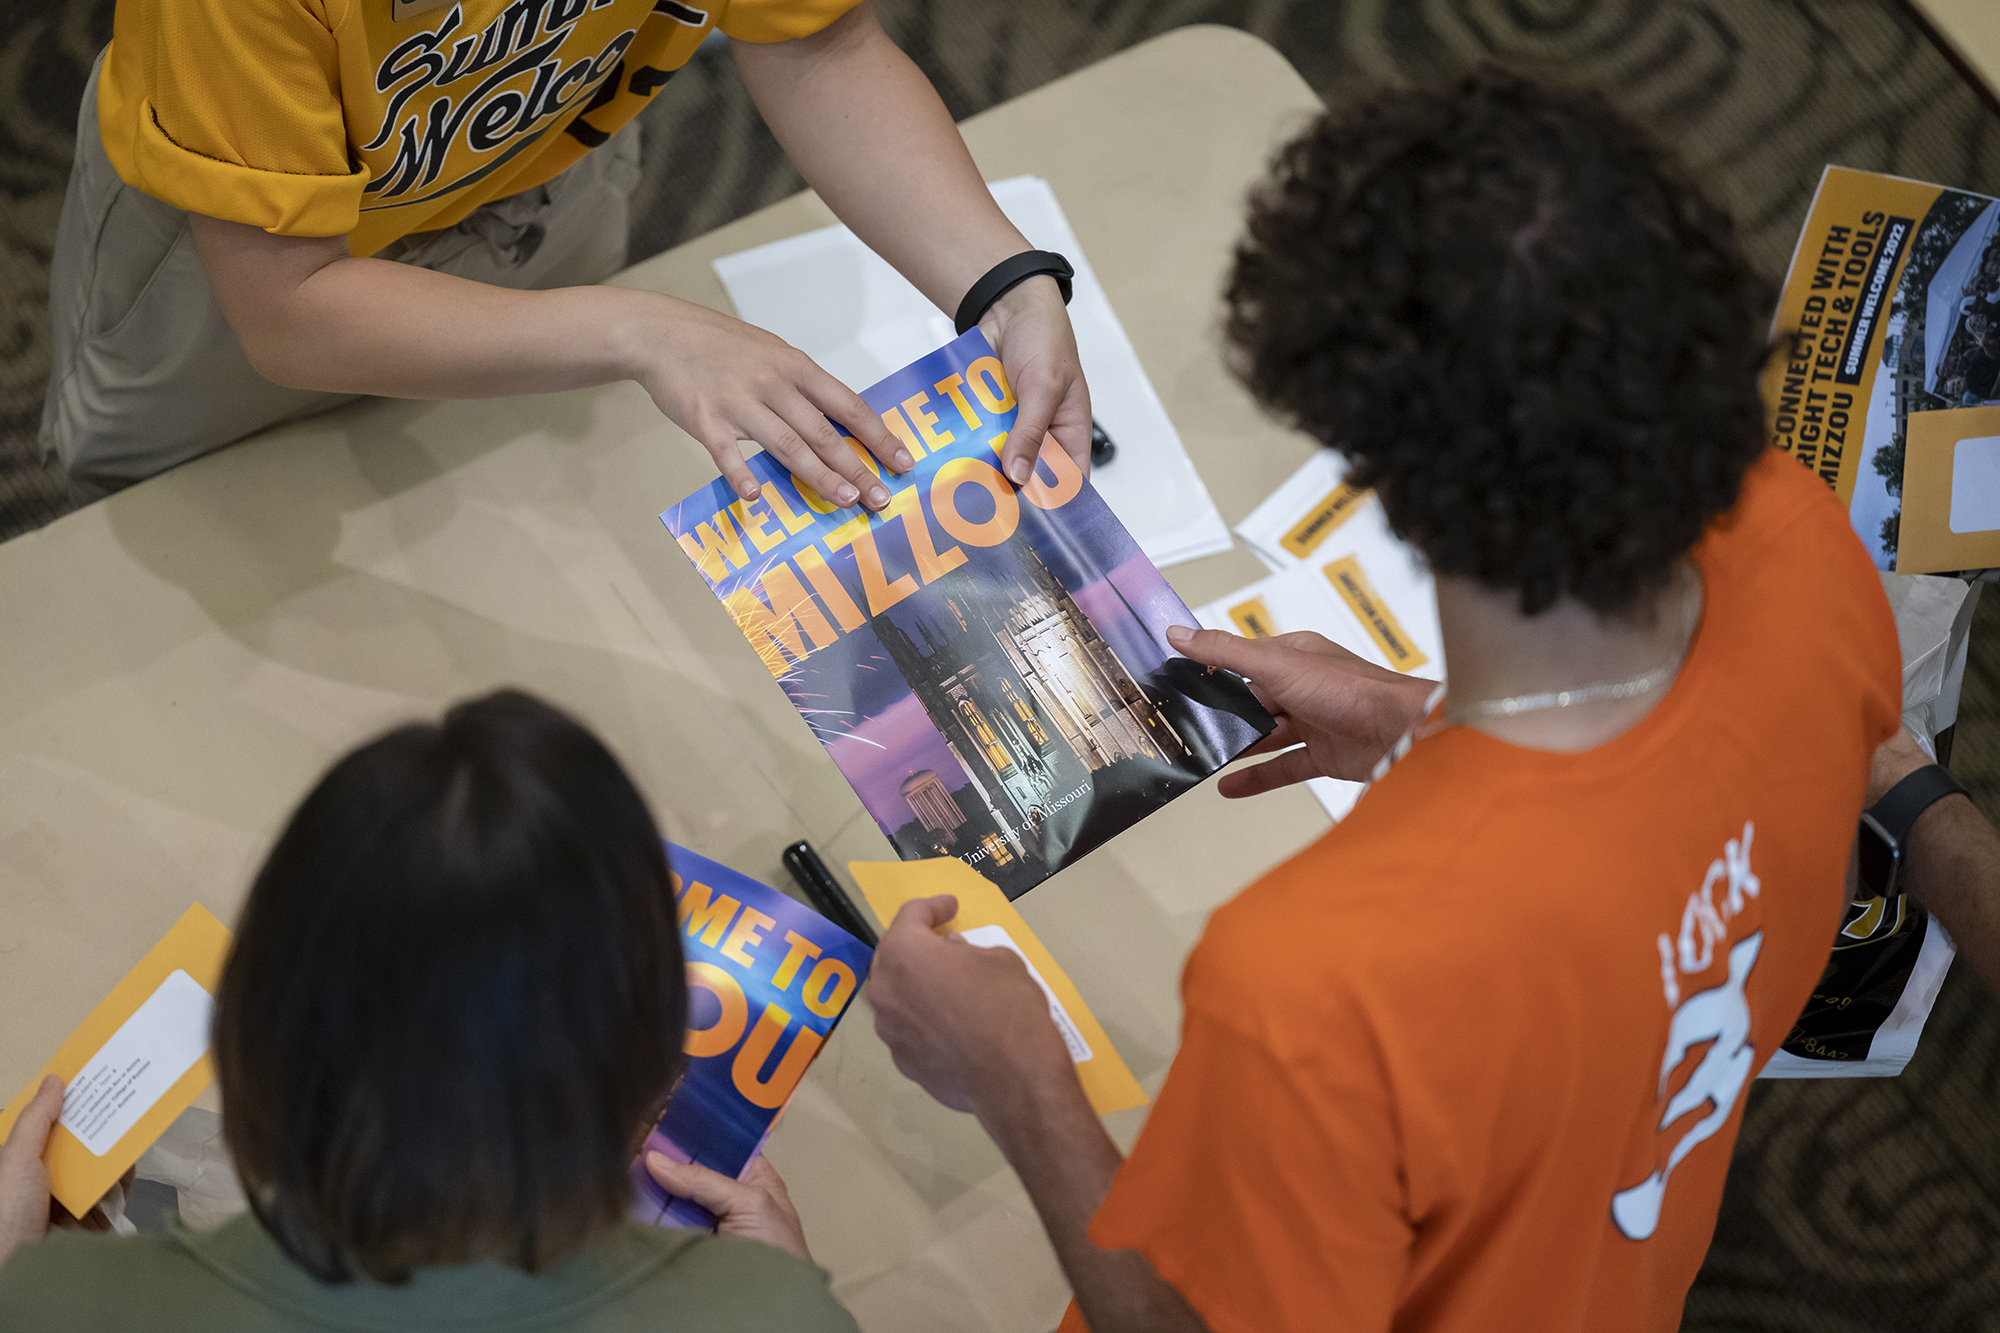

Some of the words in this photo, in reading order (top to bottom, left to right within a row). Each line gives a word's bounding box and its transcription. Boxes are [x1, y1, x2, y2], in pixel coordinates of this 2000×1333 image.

[1838, 211, 1885, 290] TOOLS
[1772, 296, 1827, 450] CONNECTED
[1811, 225, 1851, 290] WITH
[1832, 295, 1855, 314] &
[1845, 318, 1871, 375] SUMMER
[1861, 256, 1892, 319] WELCOME
[1883, 223, 1905, 258] 2022
[934, 356, 1018, 431] TO
[1811, 318, 1848, 383] TECH
[1796, 388, 1828, 470] RIGHT
[1818, 392, 1853, 491] MIZZOU
[722, 430, 1083, 678] MIZZOU
[958, 826, 1020, 867] University
[1022, 815, 1037, 831] of
[1037, 779, 1091, 822] Missouri
[771, 929, 857, 1019] TO
